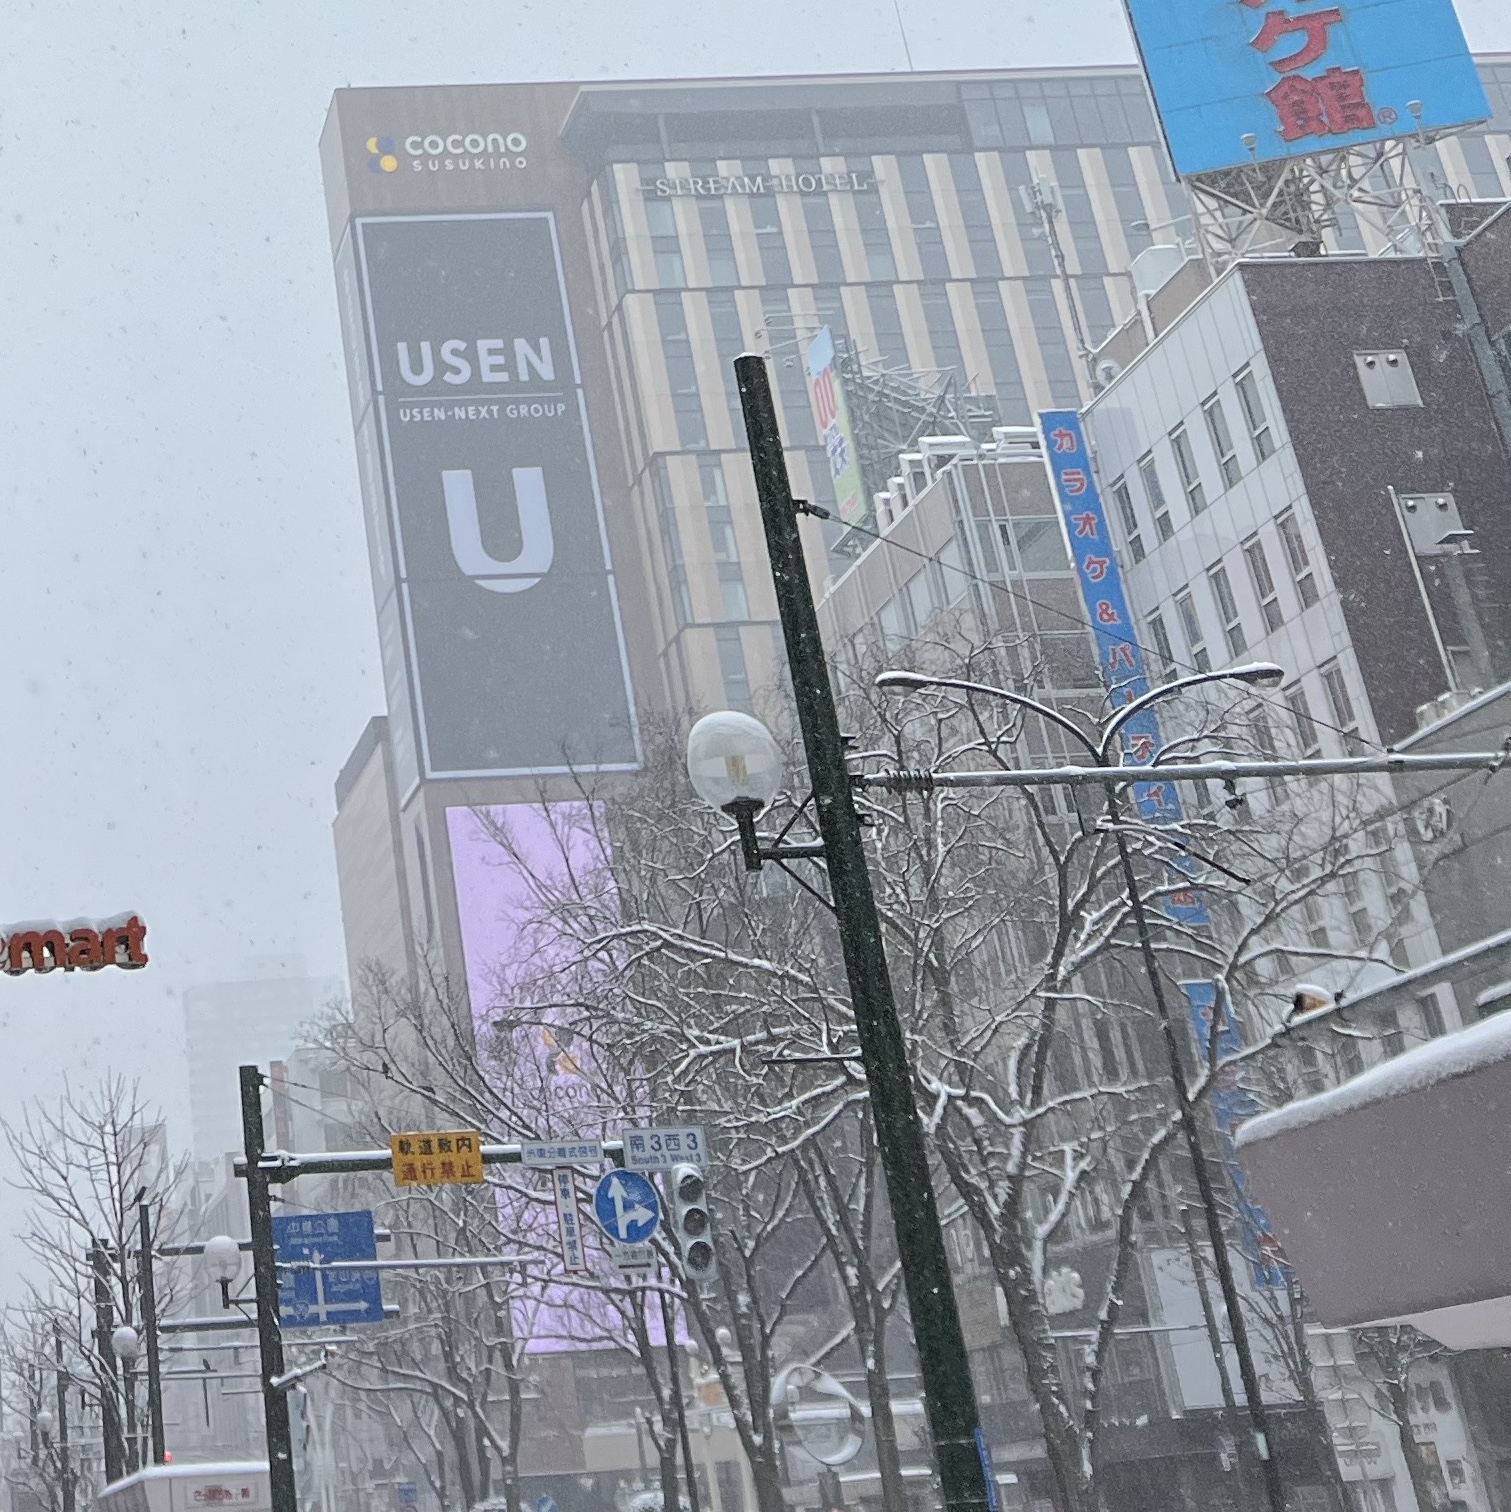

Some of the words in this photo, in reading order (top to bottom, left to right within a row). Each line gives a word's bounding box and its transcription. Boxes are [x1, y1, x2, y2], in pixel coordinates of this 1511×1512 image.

[655, 174, 767, 197] STREAM
[779, 171, 869, 193] HOTEL
[396, 337, 557, 387] USEN
[399, 405, 500, 423] USEN-NEXT
[506, 402, 567, 419] GROUP
[442, 466, 556, 595] U
